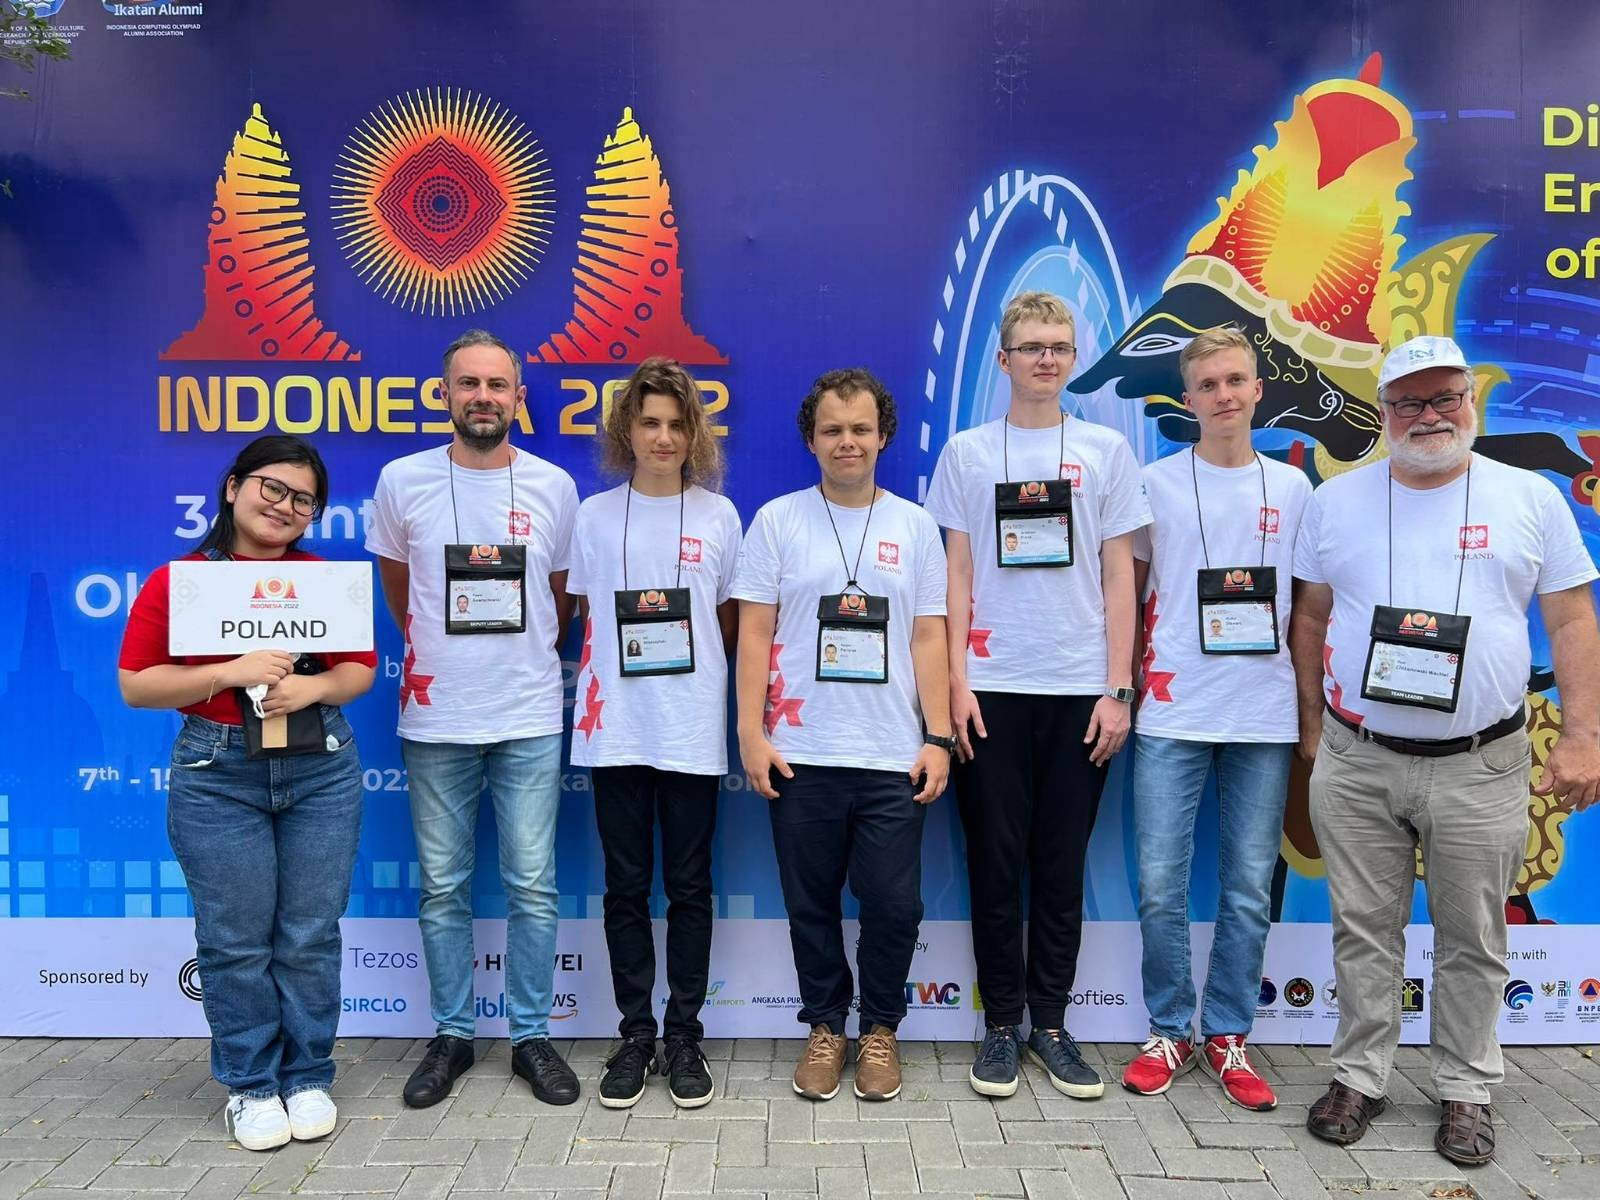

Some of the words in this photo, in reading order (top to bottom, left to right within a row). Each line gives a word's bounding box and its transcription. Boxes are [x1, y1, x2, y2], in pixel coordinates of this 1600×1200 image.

[114, 3, 156, 16] Ikatan
[159, 3, 203, 16] Alumni
[1454, 552, 1494, 560] POLAND
[874, 564, 902, 575] POLAND
[221, 620, 327, 639] POLAND
[1404, 693, 1424, 701] LEADER
[915, 942, 929, 952] by
[349, 948, 418, 969] Tezos
[1521, 949, 1547, 960] with
[39, 969, 124, 987] Sponsored
[130, 969, 149, 988] by
[904, 982, 961, 1005] TWC
[343, 998, 407, 1013] SIRCLO
[752, 996, 786, 1004] ANGKASA
